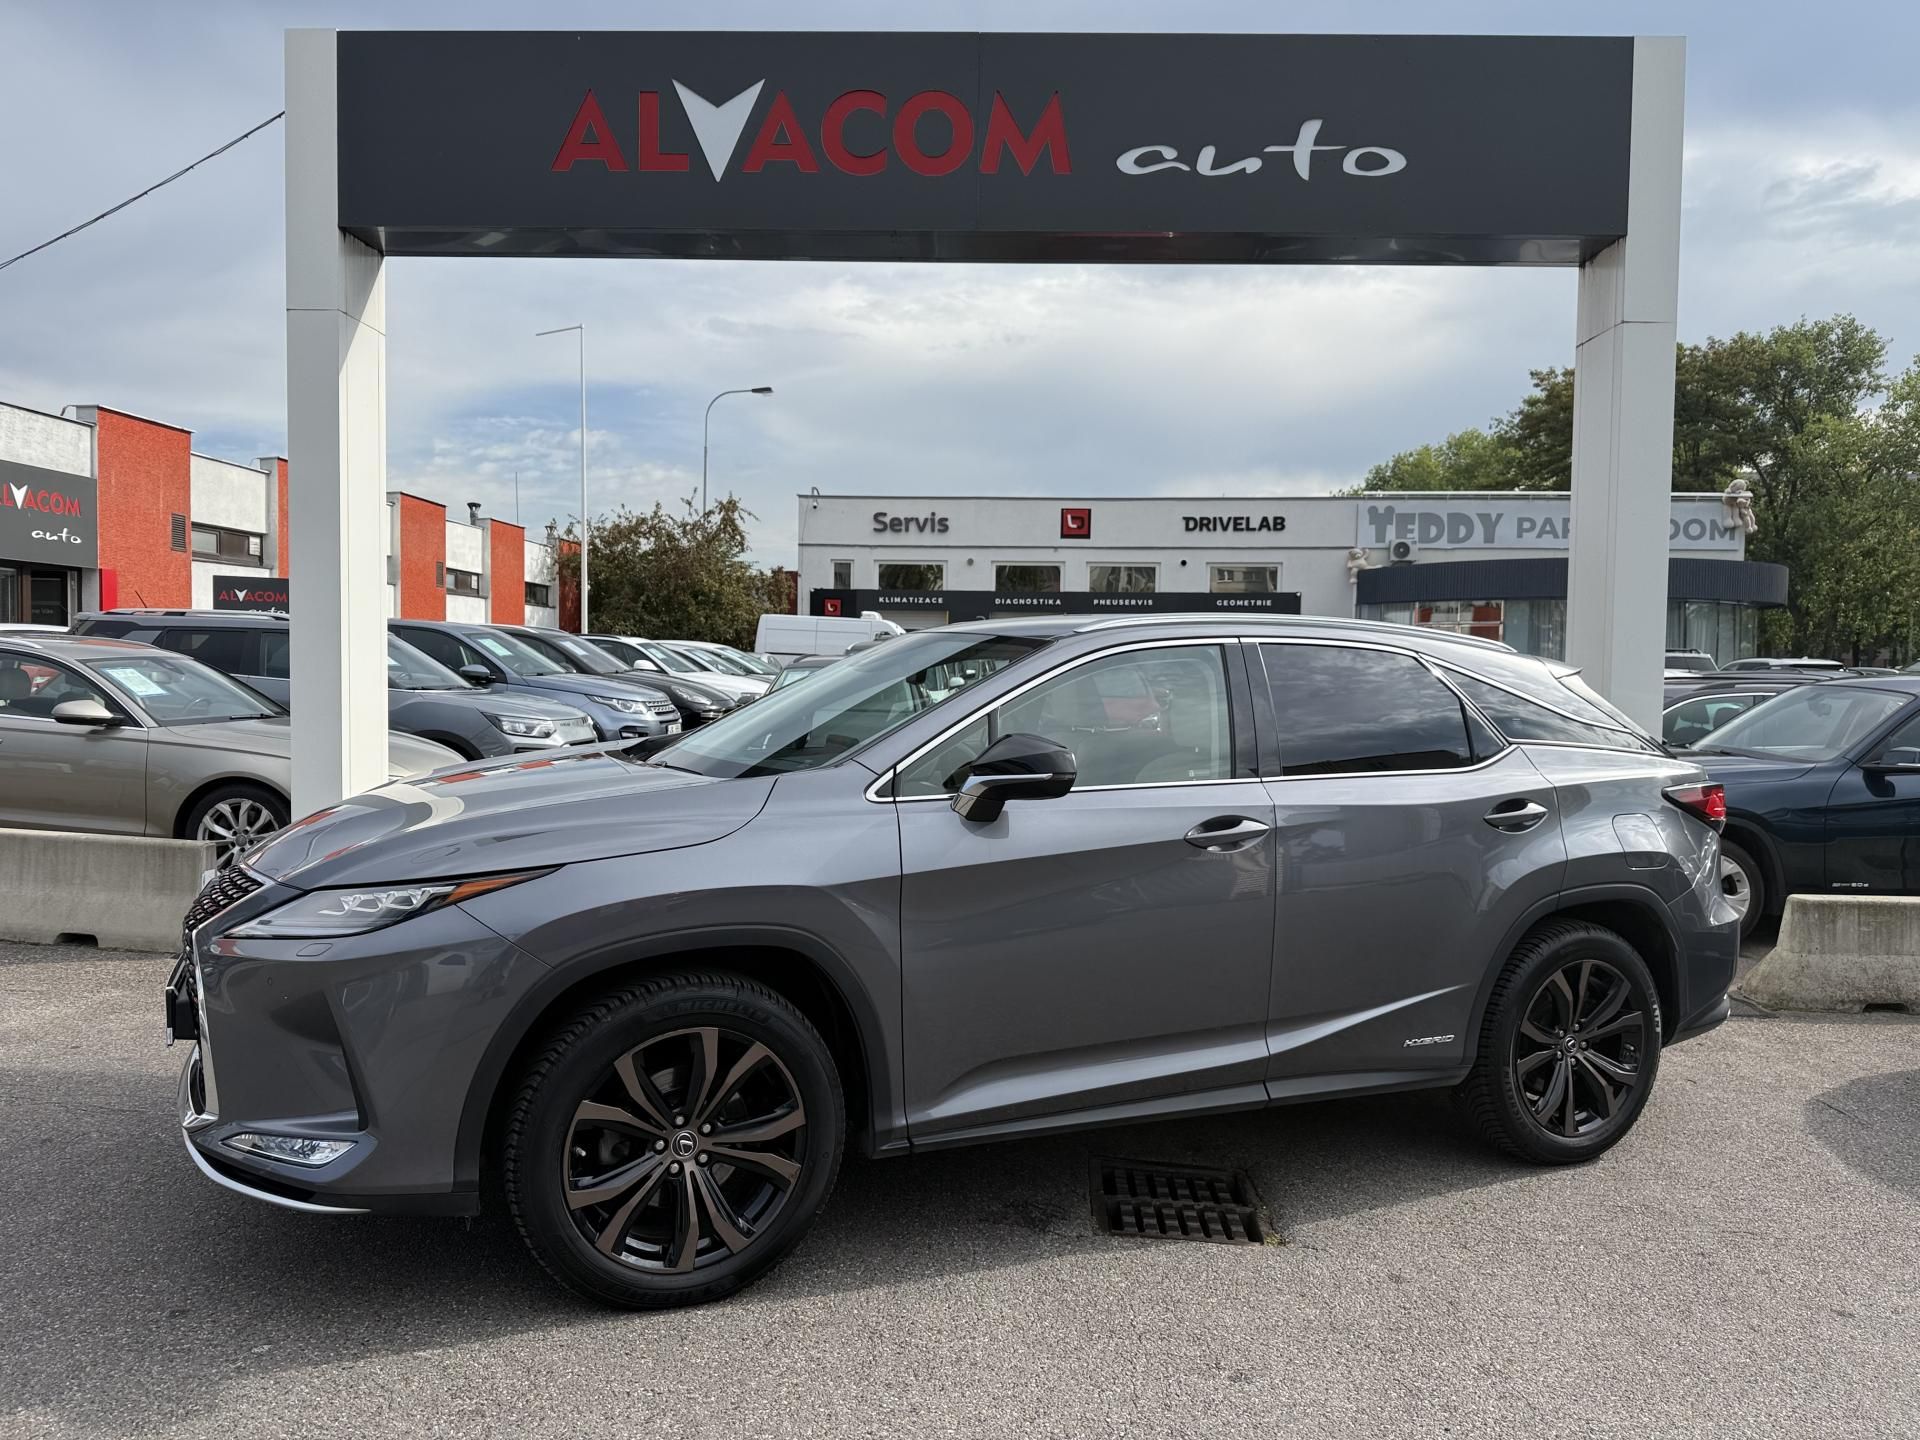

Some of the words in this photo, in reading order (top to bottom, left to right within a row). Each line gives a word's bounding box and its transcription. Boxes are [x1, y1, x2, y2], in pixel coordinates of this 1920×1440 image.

[551, 78, 1072, 182] ALVACOM
[1116, 119, 1407, 181] auto
[0, 482, 81, 518] LVACOM
[873, 512, 949, 533] Servis
[1182, 516, 1286, 532] DRIVELAB
[1367, 505, 1504, 544] TEDDY
[31, 527, 82, 544] auto
[219, 588, 287, 602] ALVACOM
[878, 596, 944, 604] KLIMATIZACE
[1216, 599, 1272, 607] GEOMETRIE
